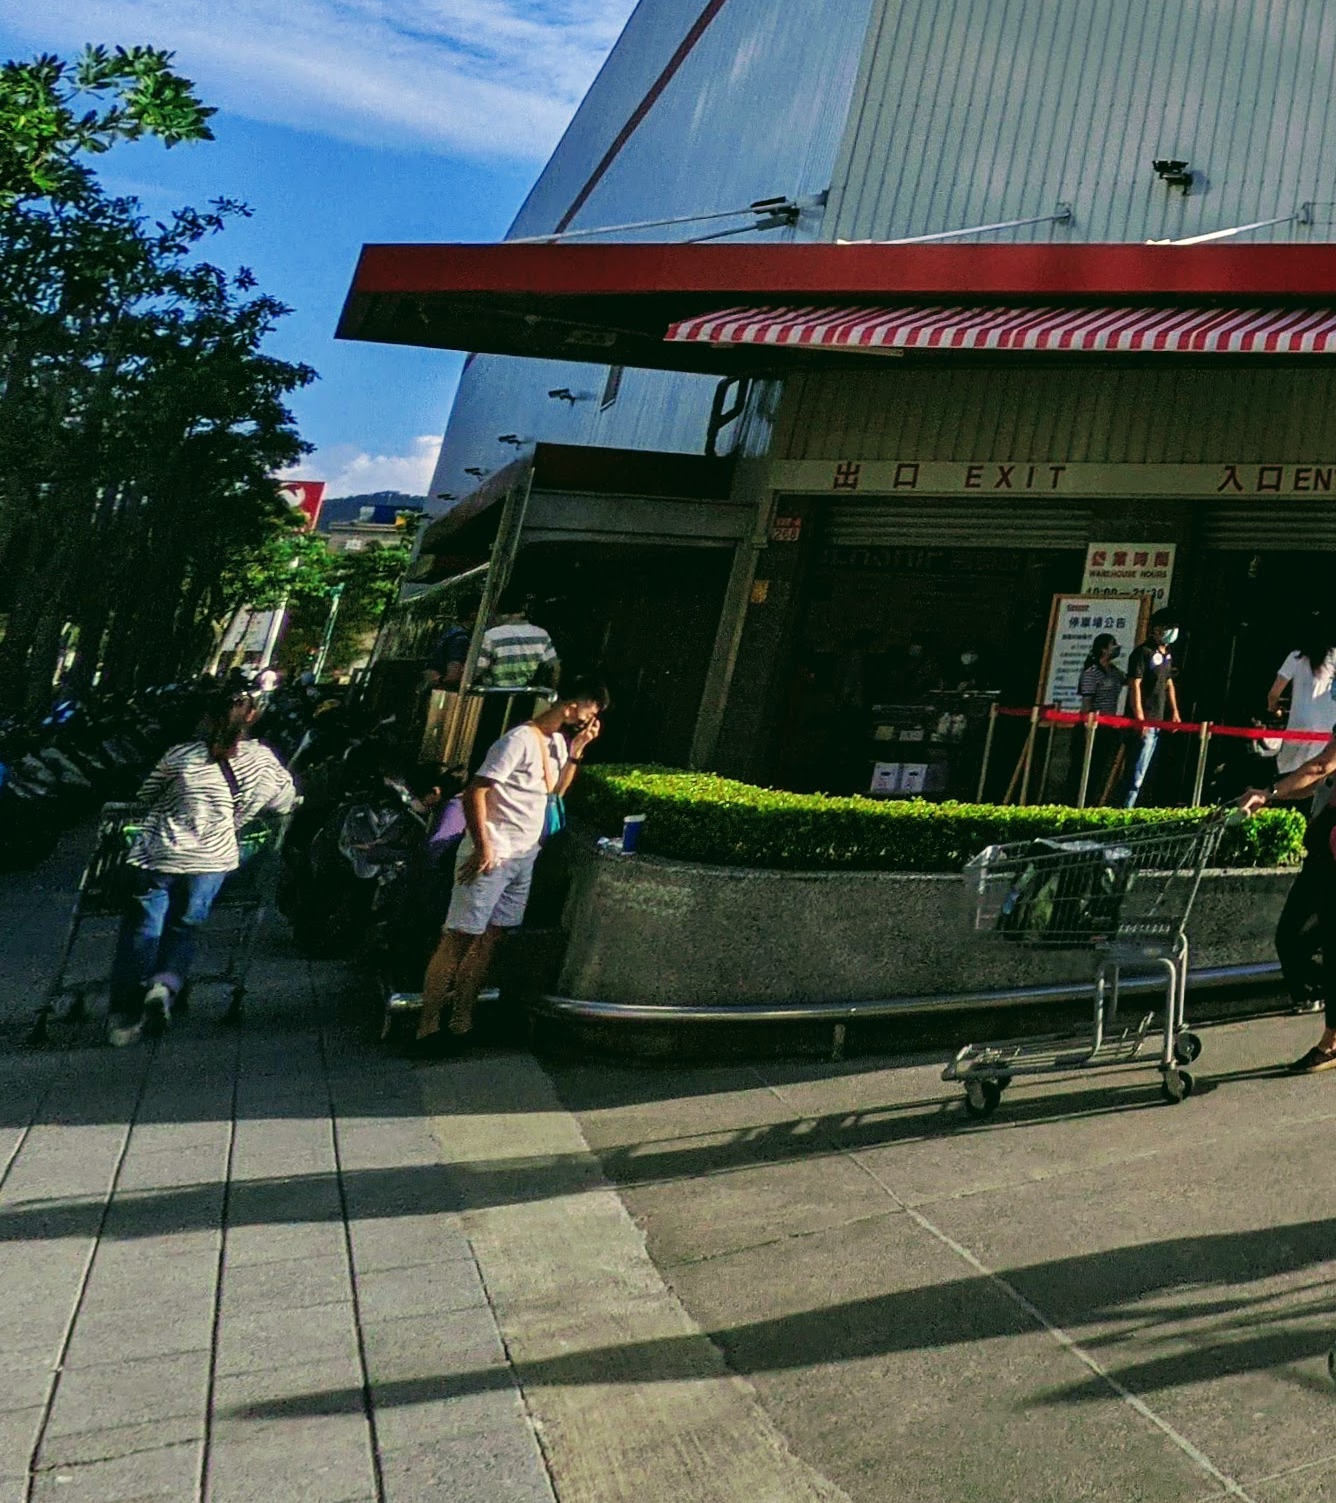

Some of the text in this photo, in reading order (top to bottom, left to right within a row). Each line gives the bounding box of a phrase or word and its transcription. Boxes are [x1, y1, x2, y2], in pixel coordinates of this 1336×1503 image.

[833, 462, 1067, 489] 出口 EXIT
[1217, 465, 1283, 491] 入口
[1089, 570, 1168, 578] WAREHOUSE HOURS
